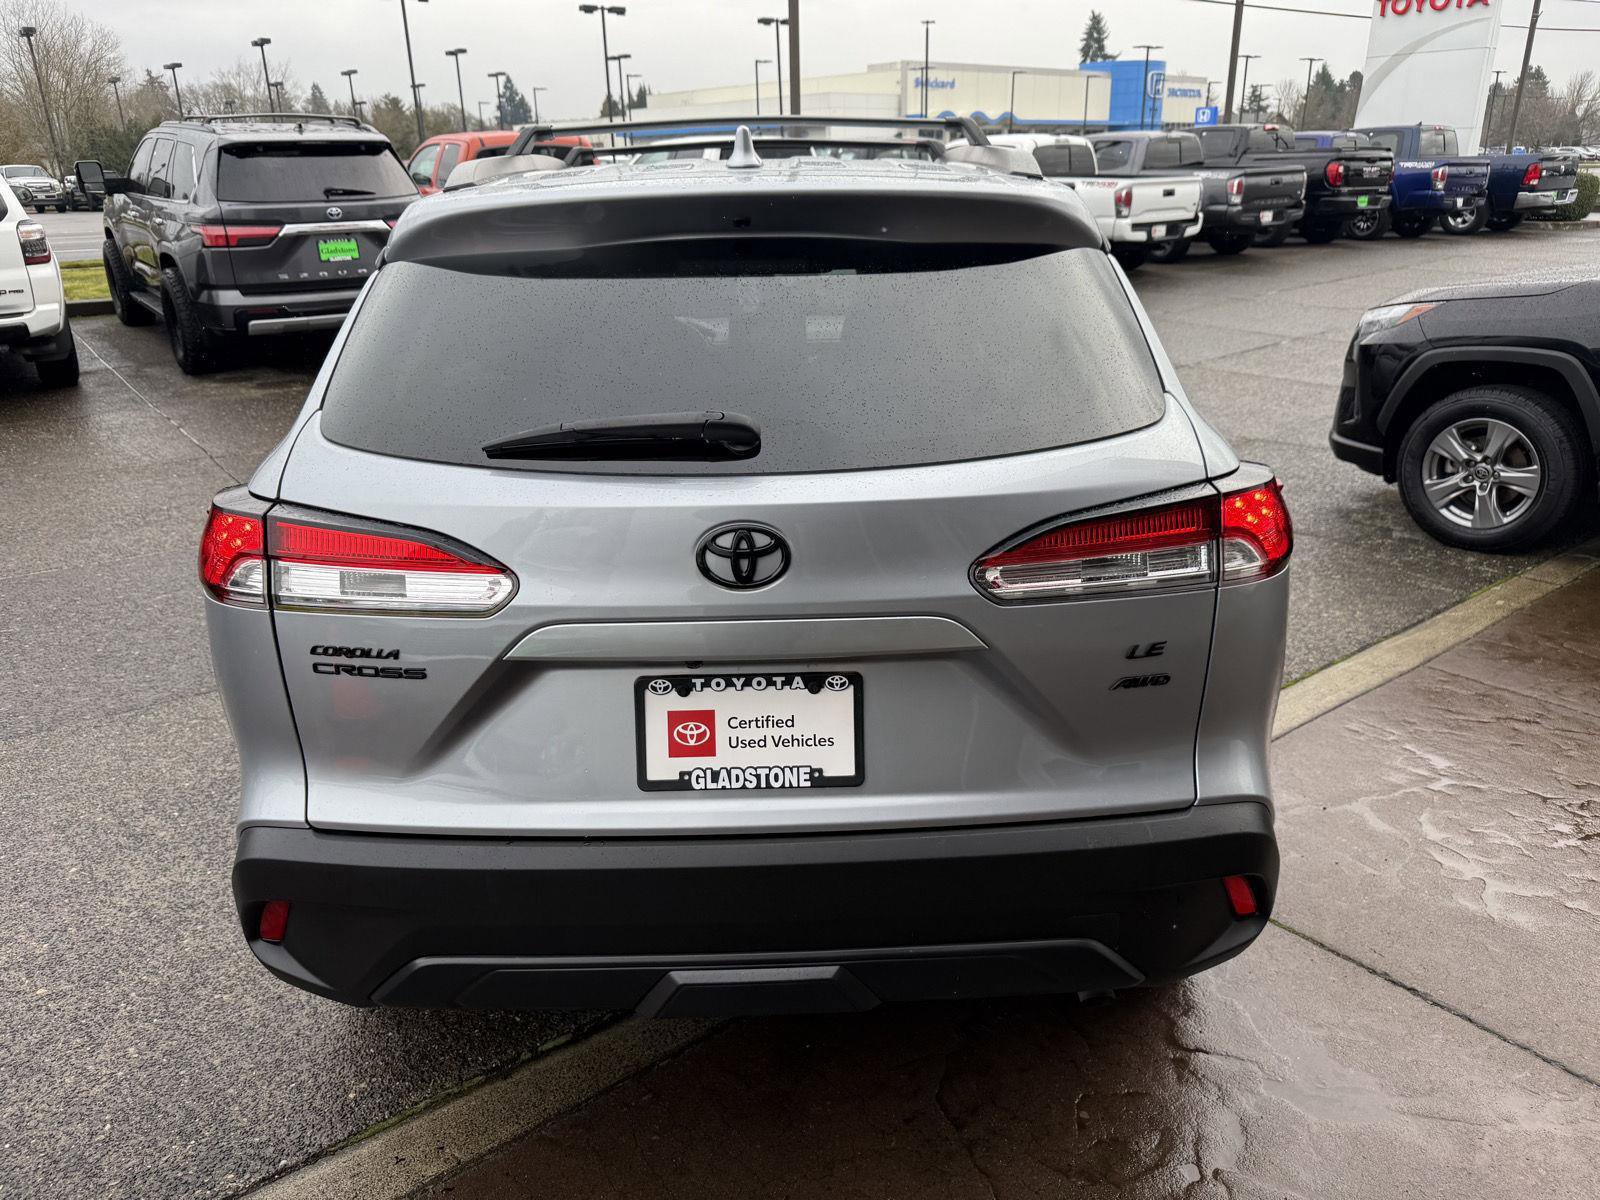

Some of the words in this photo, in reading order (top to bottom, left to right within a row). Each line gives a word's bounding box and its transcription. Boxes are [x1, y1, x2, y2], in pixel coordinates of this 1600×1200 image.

[310, 645, 400, 660] COROLLA
[1125, 640, 1168, 660] LE
[312, 662, 427, 680] CROSS
[692, 676, 806, 692] TOYOTA
[727, 715, 795, 730] Certified
[728, 735, 768, 749] Used
[771, 734, 835, 748] Vehicles
[690, 767, 812, 790] GLADSTONE
